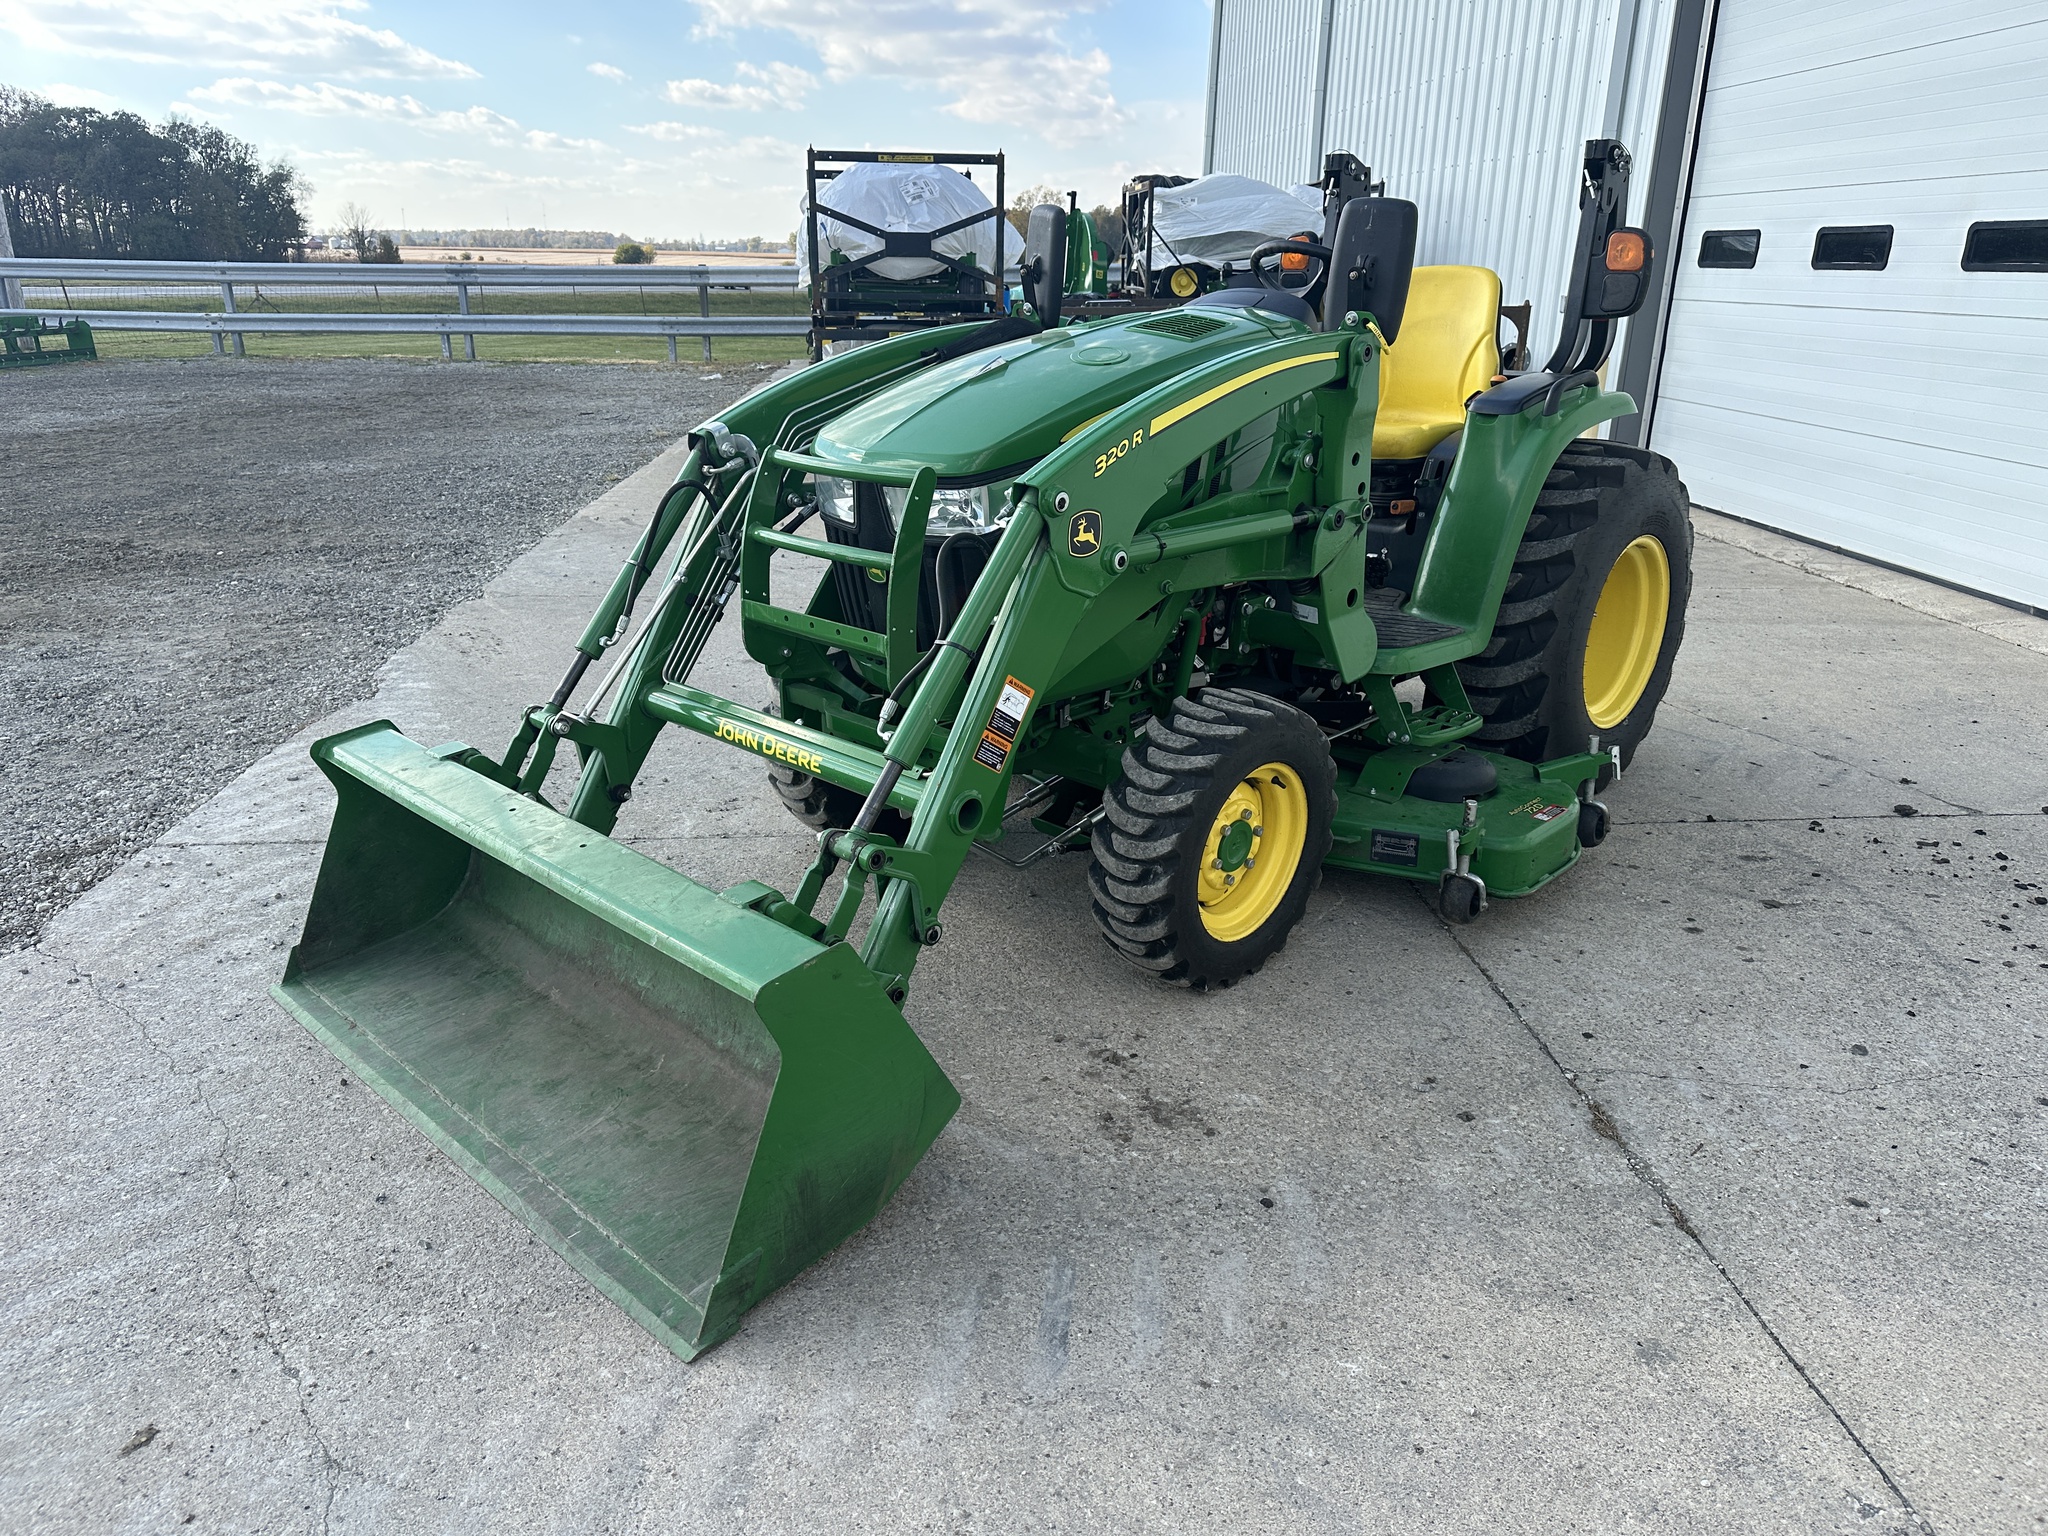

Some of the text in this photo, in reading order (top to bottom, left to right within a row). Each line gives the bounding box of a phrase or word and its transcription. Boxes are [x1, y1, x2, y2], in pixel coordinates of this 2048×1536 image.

[1094, 428, 1144, 478] 320 R
[1013, 681, 1031, 695] WARNING
[713, 718, 823, 774] JOHN DEERE
[989, 737, 1009, 750] WARNING
